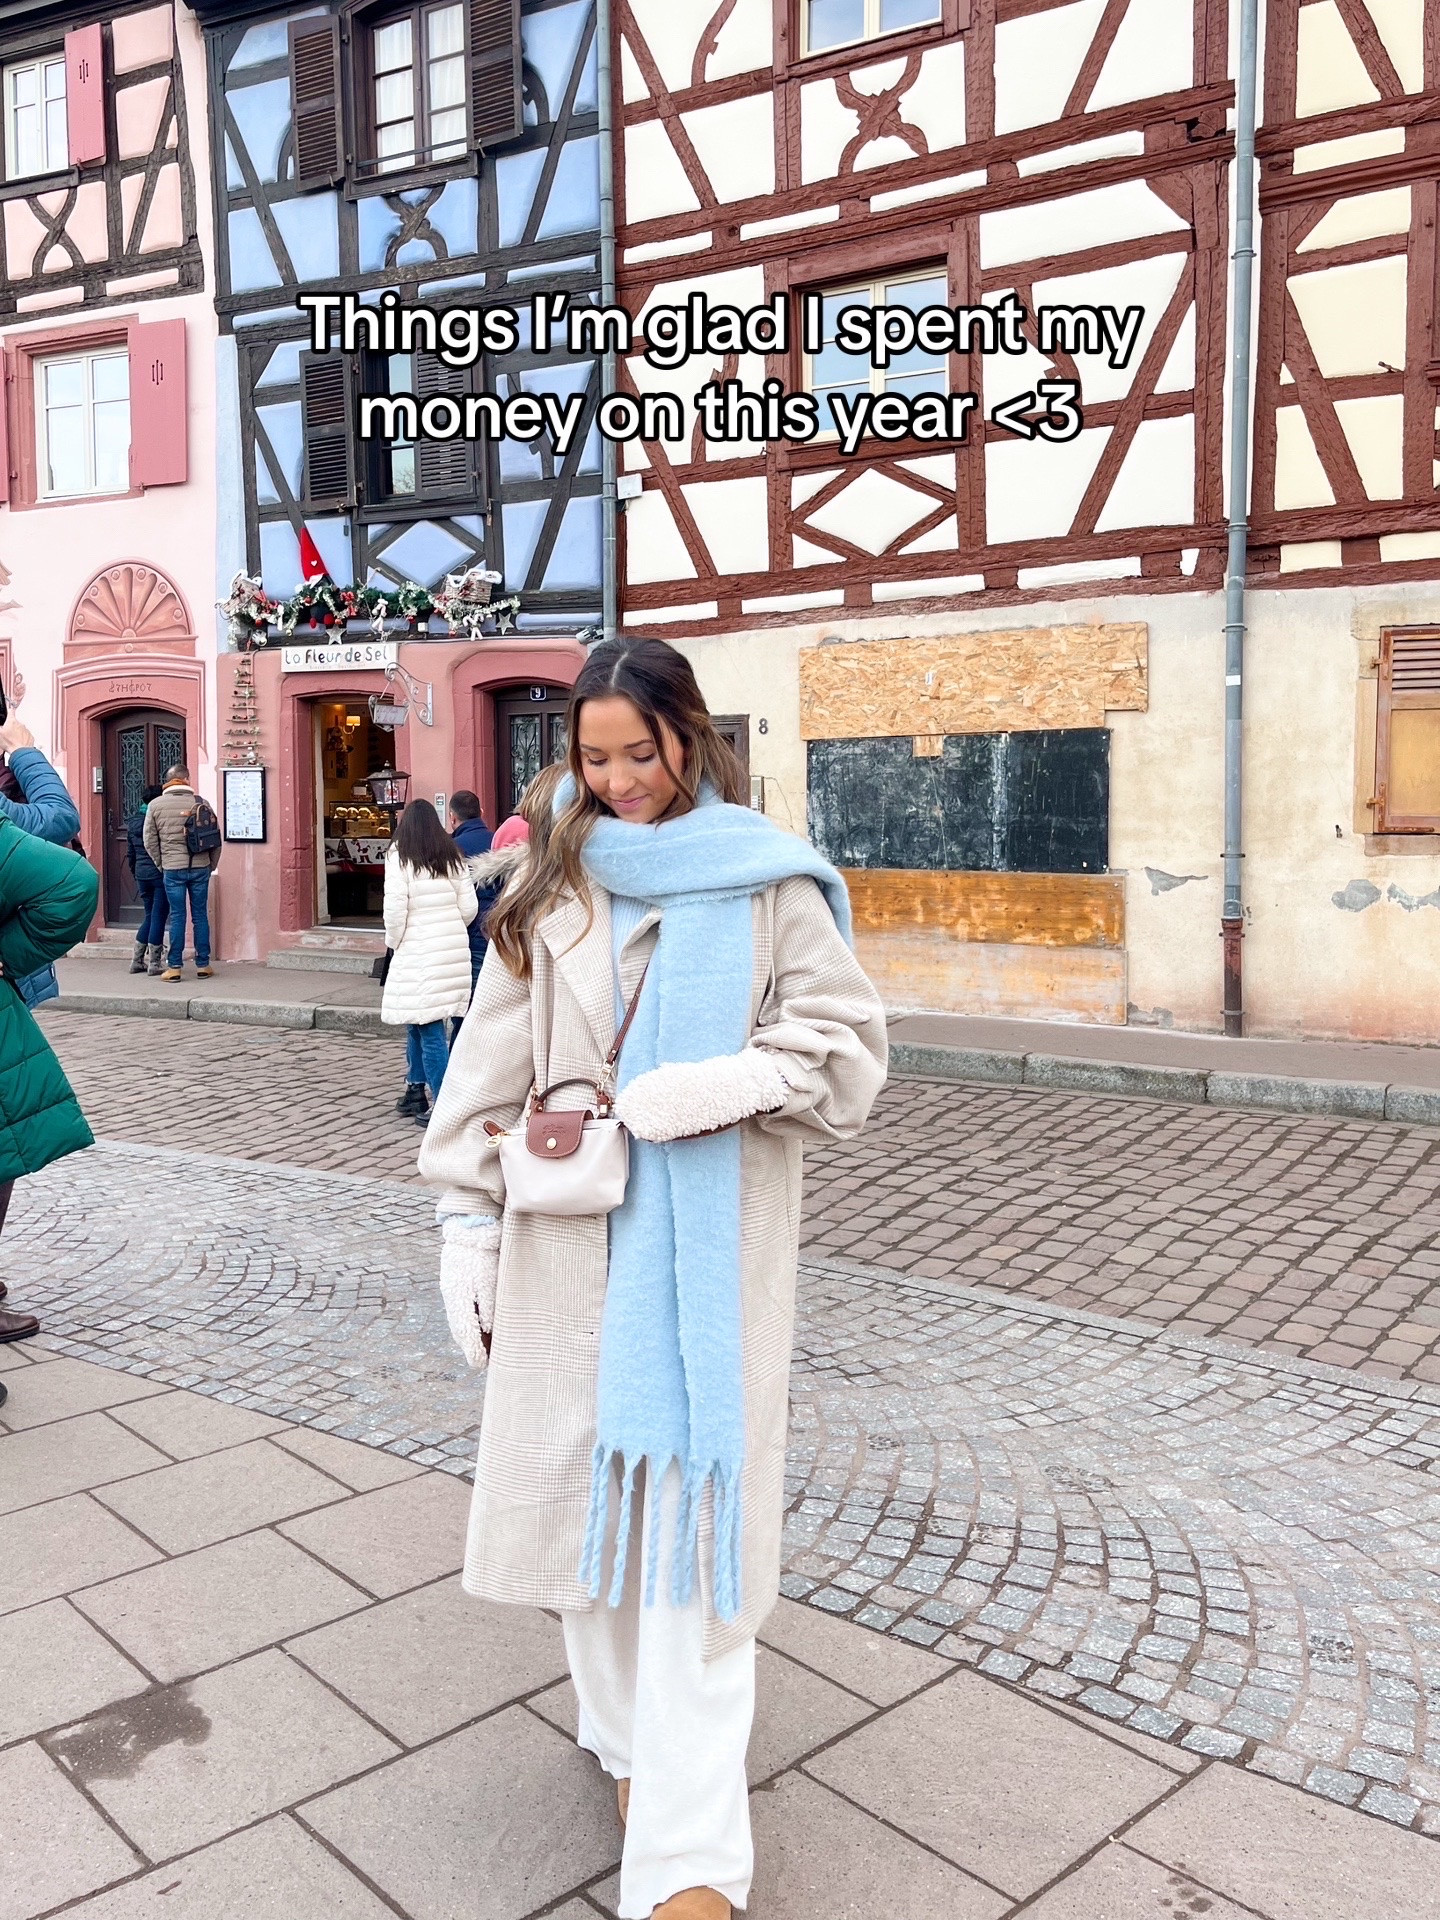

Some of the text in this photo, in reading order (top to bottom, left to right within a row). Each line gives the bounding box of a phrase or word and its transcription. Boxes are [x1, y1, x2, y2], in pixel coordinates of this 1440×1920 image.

[345, 647, 361, 662] de
[365, 646, 388, 661] Sel
[759, 718, 768, 735] 8
